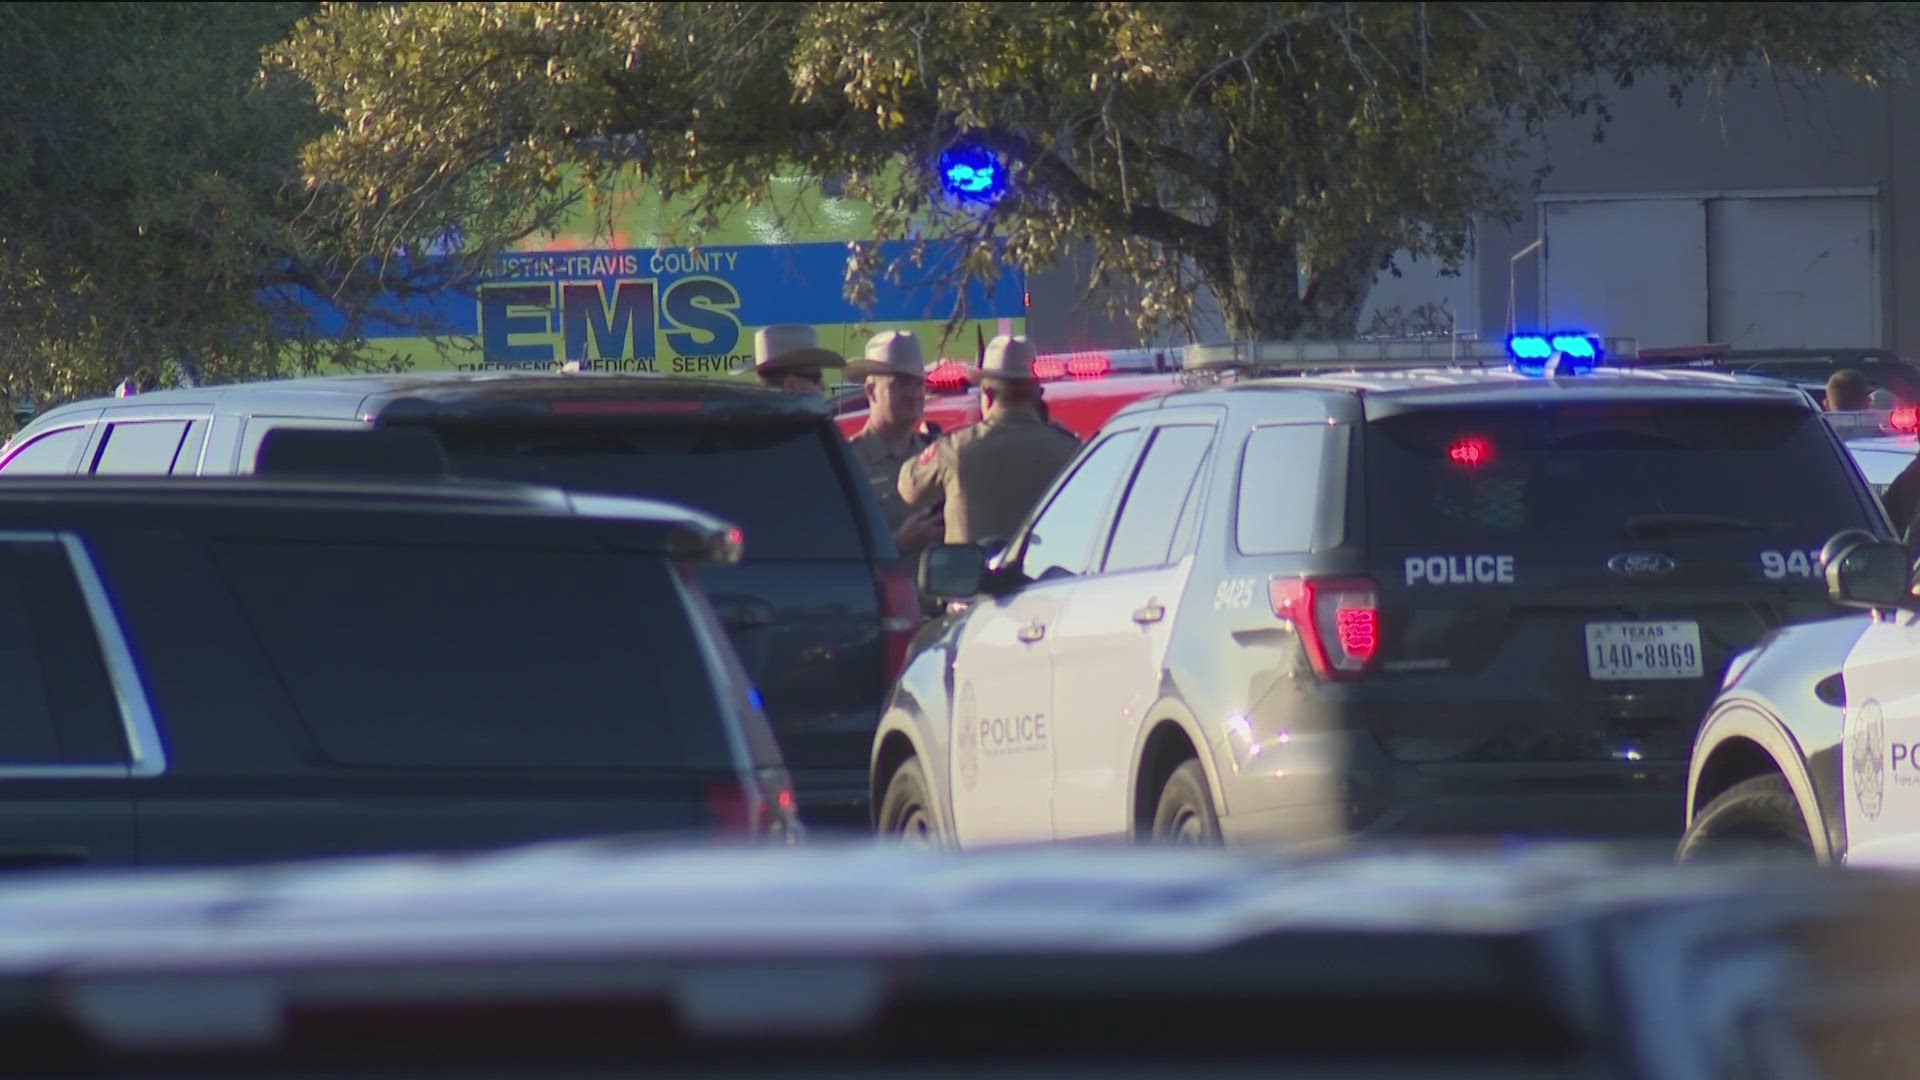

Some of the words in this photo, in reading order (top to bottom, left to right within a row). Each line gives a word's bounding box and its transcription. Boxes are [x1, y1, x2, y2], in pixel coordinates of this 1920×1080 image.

[649, 252, 738, 274] COUNTY
[477, 276, 741, 362] EMS
[1405, 555, 1514, 585] POLICE
[1622, 625, 1664, 637] TEXAS
[980, 714, 1046, 746] POLICE
